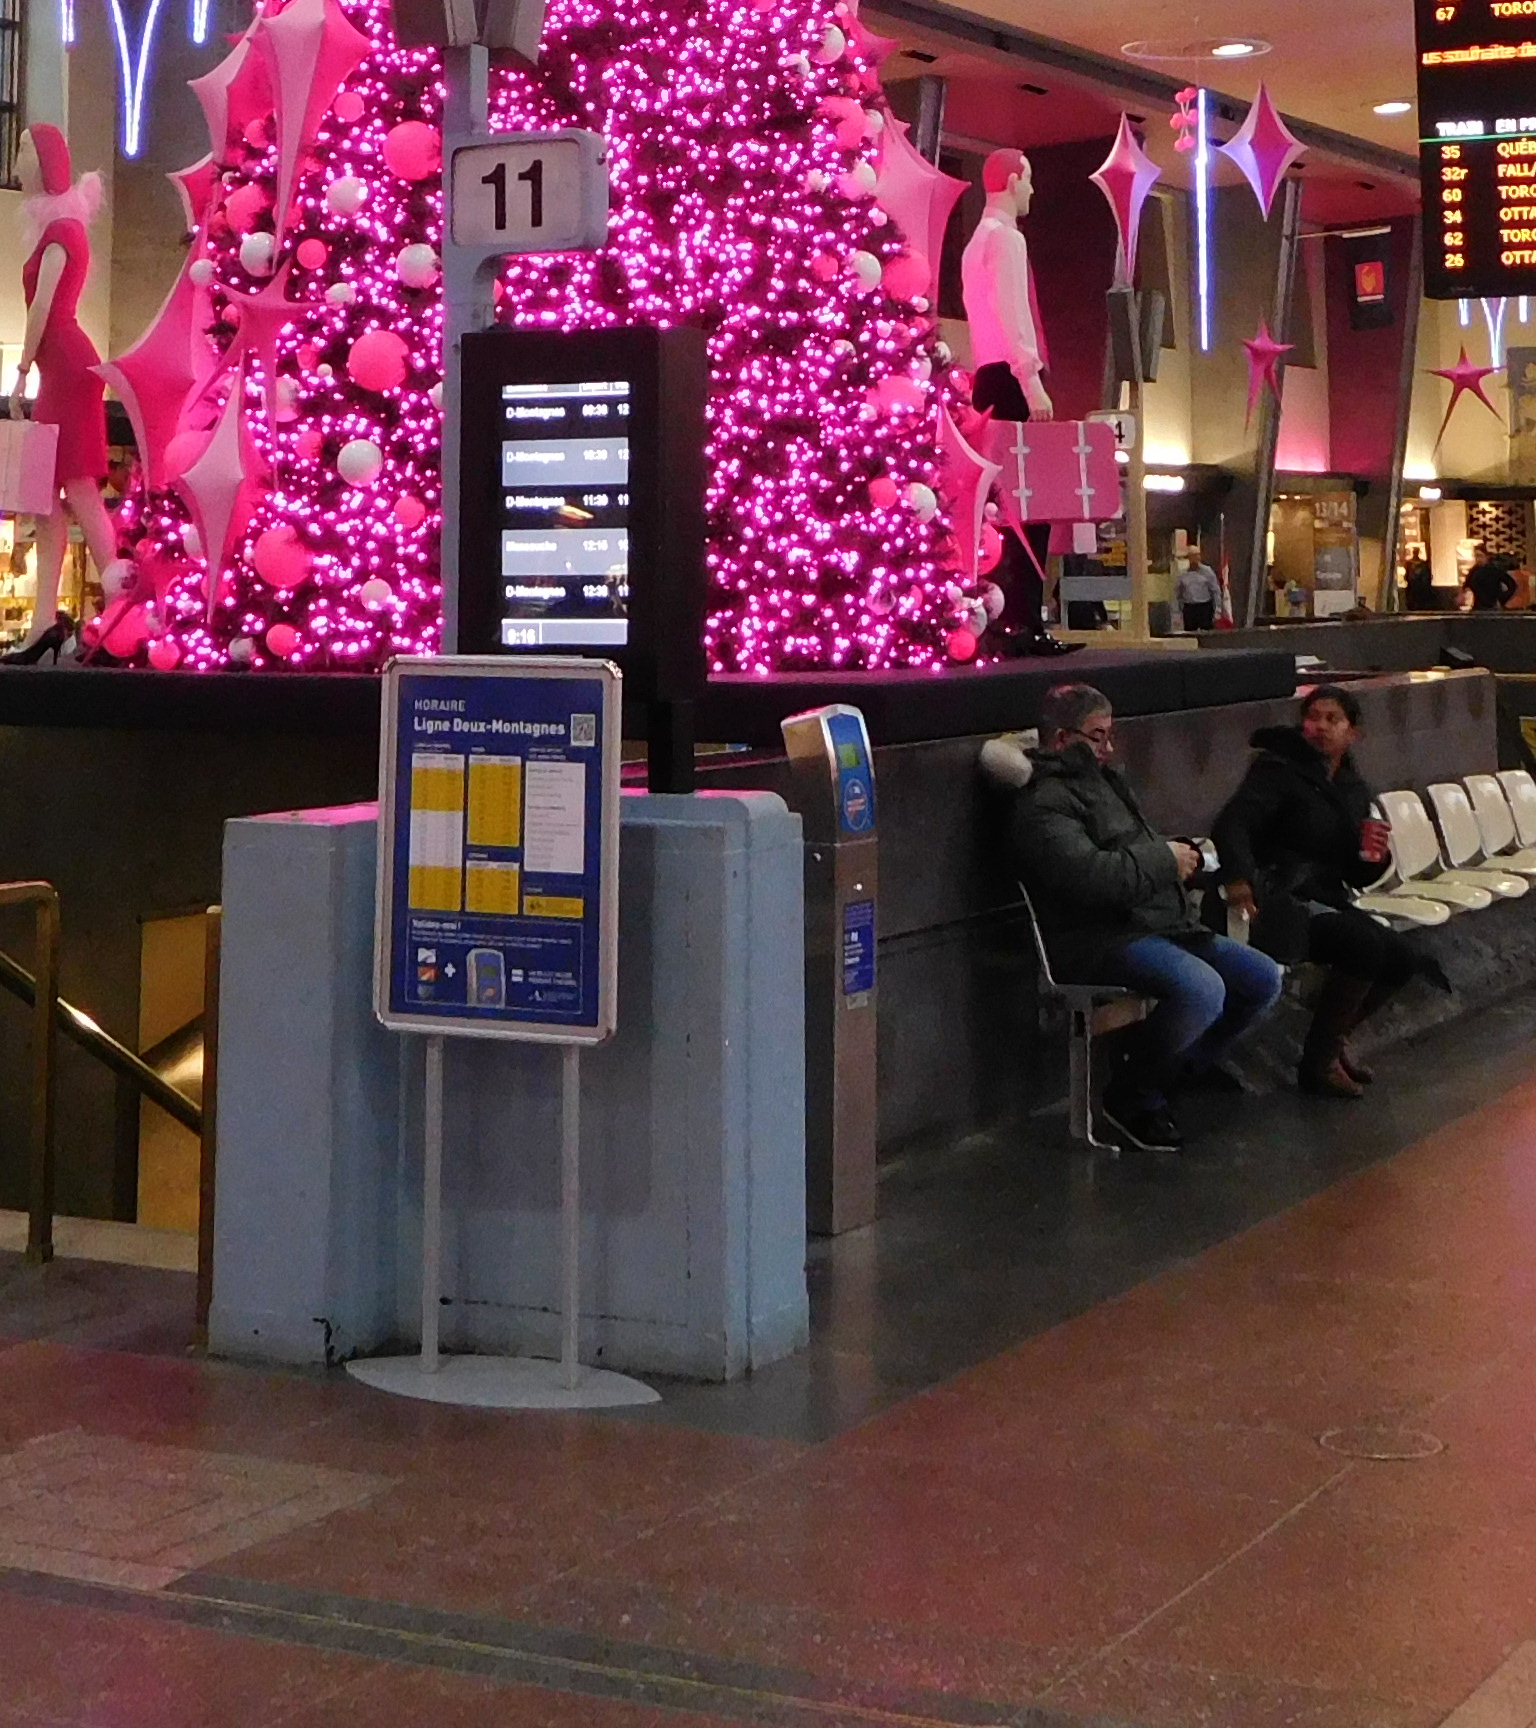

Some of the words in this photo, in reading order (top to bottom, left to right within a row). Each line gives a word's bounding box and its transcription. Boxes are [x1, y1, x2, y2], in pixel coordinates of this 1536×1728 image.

[1436, 7, 1456, 22] 67
[1436, 120, 1484, 138] TRAIN
[1441, 145, 1461, 160] 35
[1441, 167, 1469, 182] 32r
[481, 159, 544, 231] 11
[1442, 188, 1462, 203] 60
[1443, 209, 1463, 224] 34
[1444, 231, 1464, 247] 62
[1444, 253, 1465, 268] 26
[414, 699, 466, 712] HORAIRE
[413, 716, 451, 734] Ligne
[453, 717, 566, 738] Deux-Montagnes
